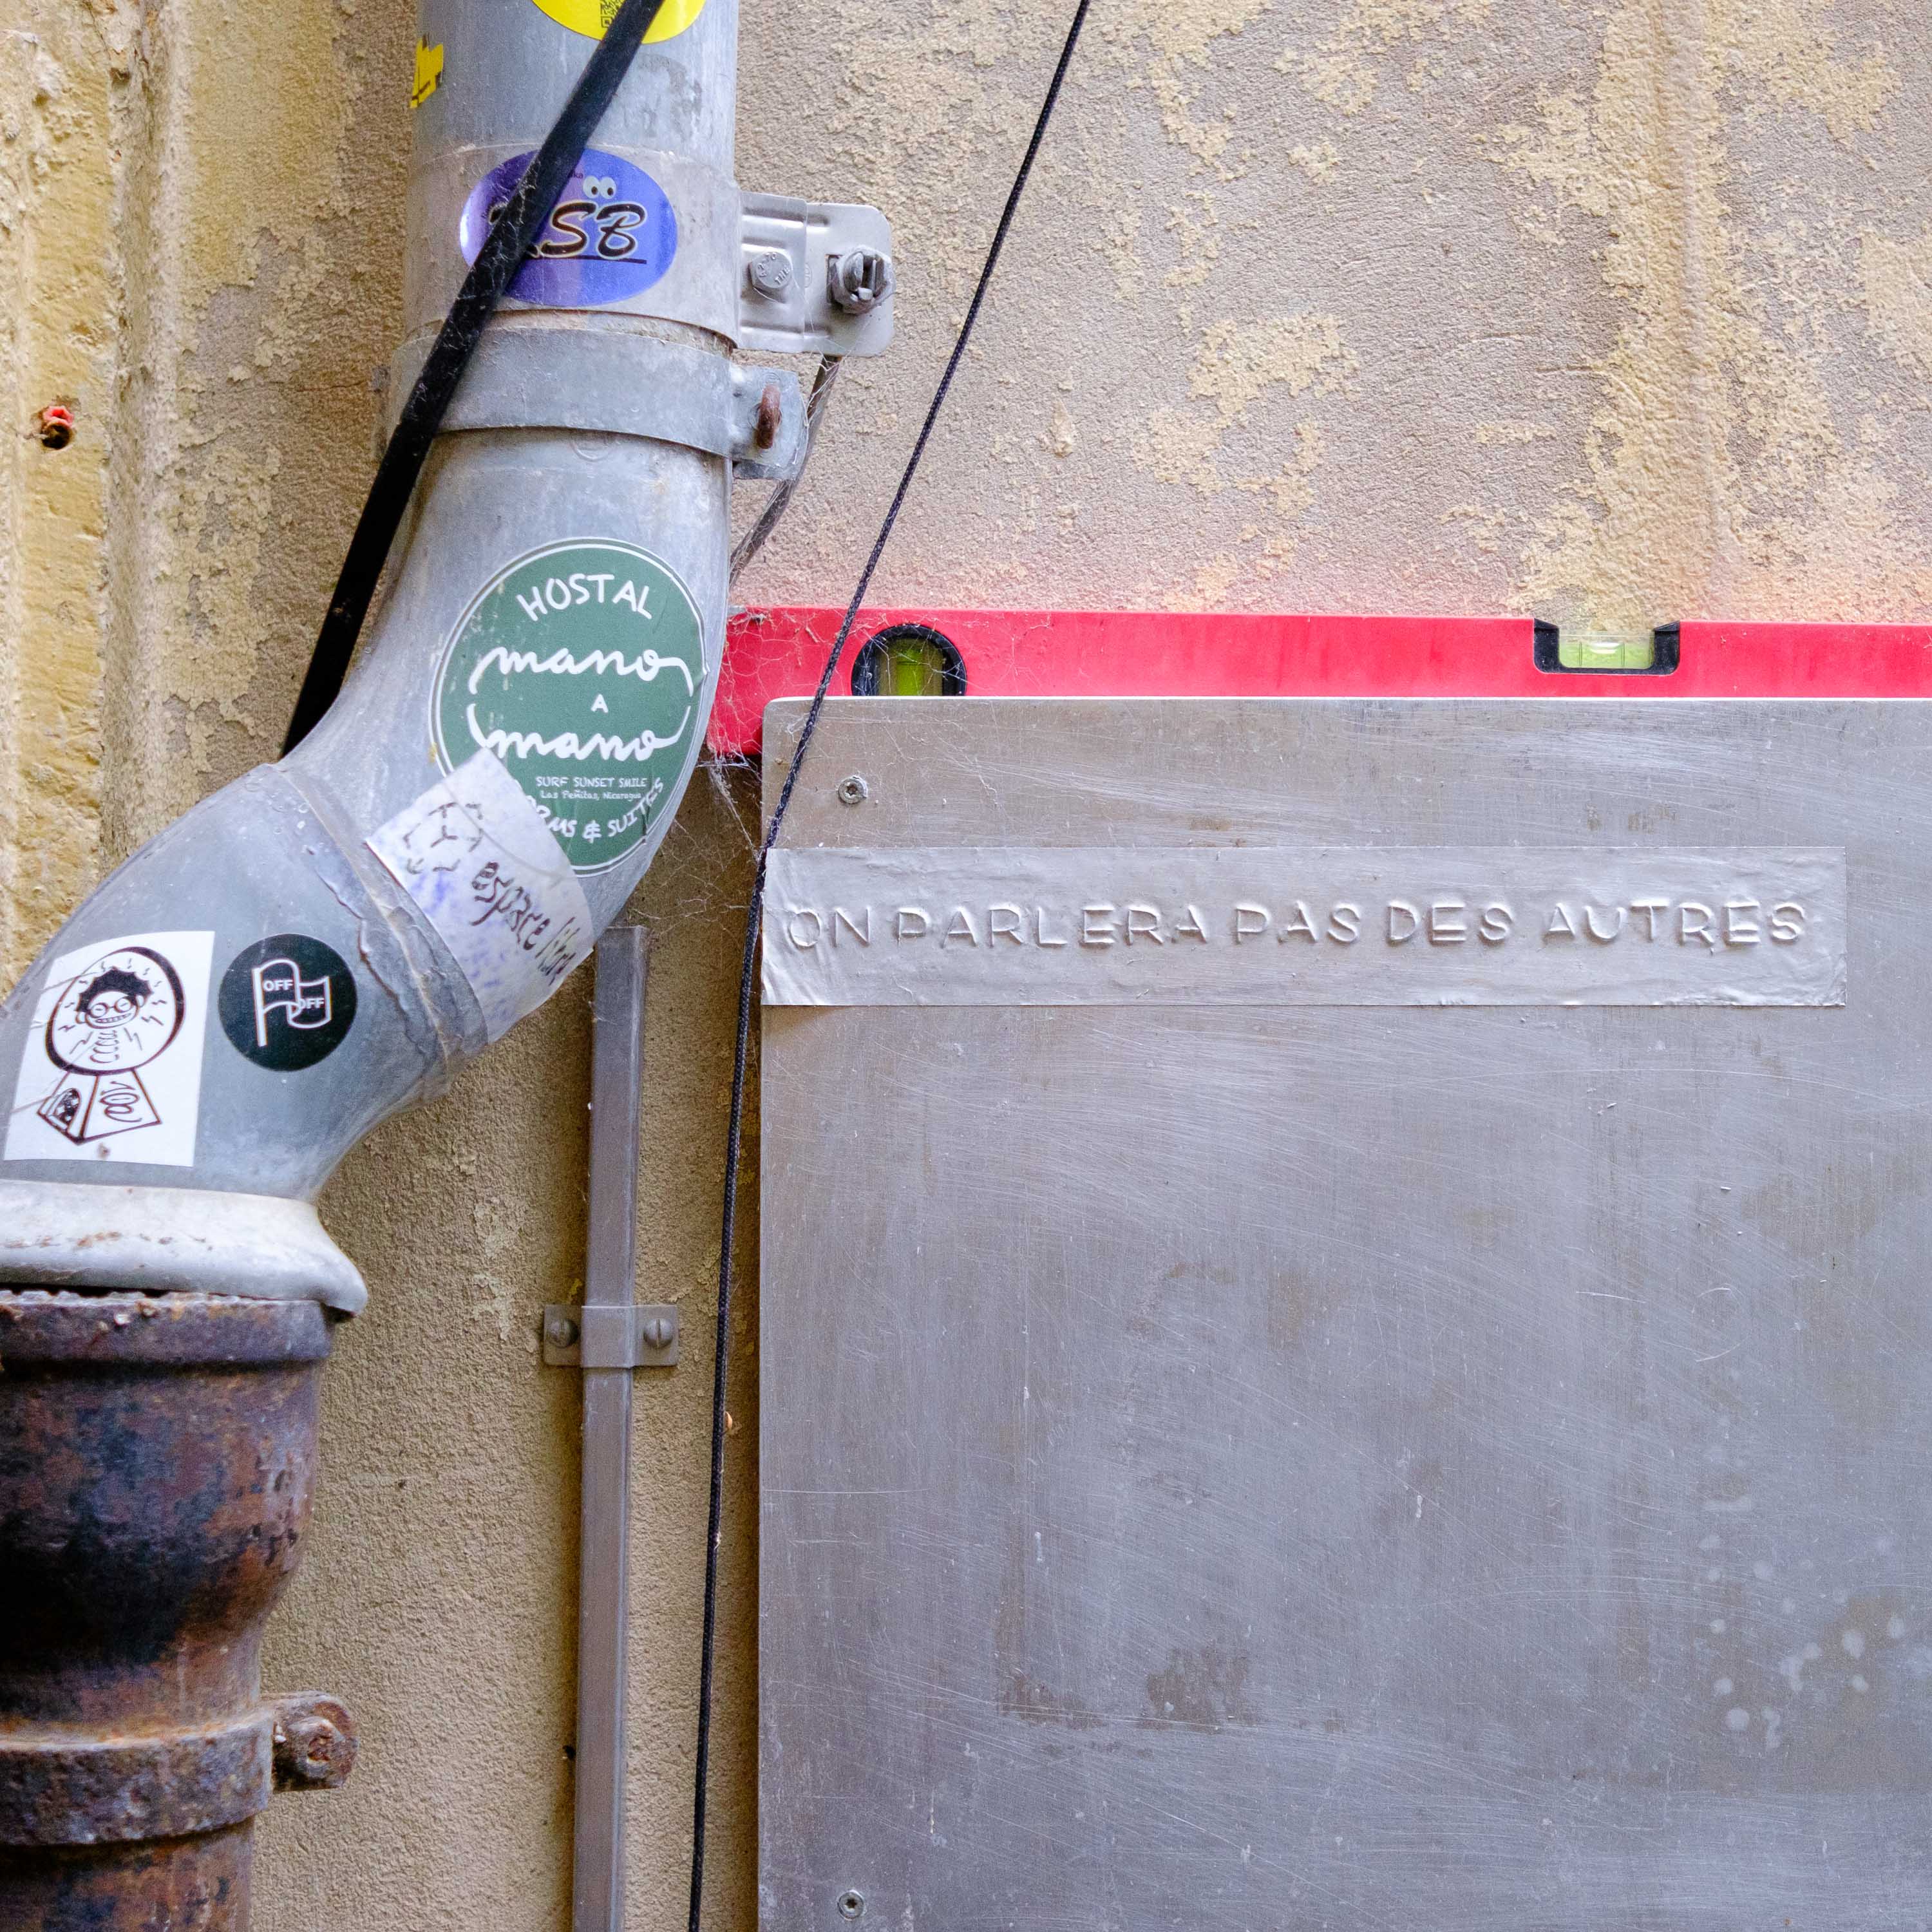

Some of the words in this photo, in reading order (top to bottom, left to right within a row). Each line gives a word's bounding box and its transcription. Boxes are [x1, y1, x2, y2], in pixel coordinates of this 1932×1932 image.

[516, 573, 652, 621] HOSTAL
[469, 647, 694, 697] mano
[591, 694, 609, 713] A
[466, 703, 691, 761] mano
[535, 776, 569, 787] SURF
[573, 777, 616, 788] SUNSET
[619, 777, 648, 788] SMILE
[540, 790, 559, 799] Las
[607, 777, 664, 837] SUITES
[788, 904, 872, 949] ON
[1234, 901, 1361, 945] PAS
[1386, 902, 1513, 944] DES
[1546, 899, 1807, 945] AUTRES
[263, 979, 294, 992] OFF
